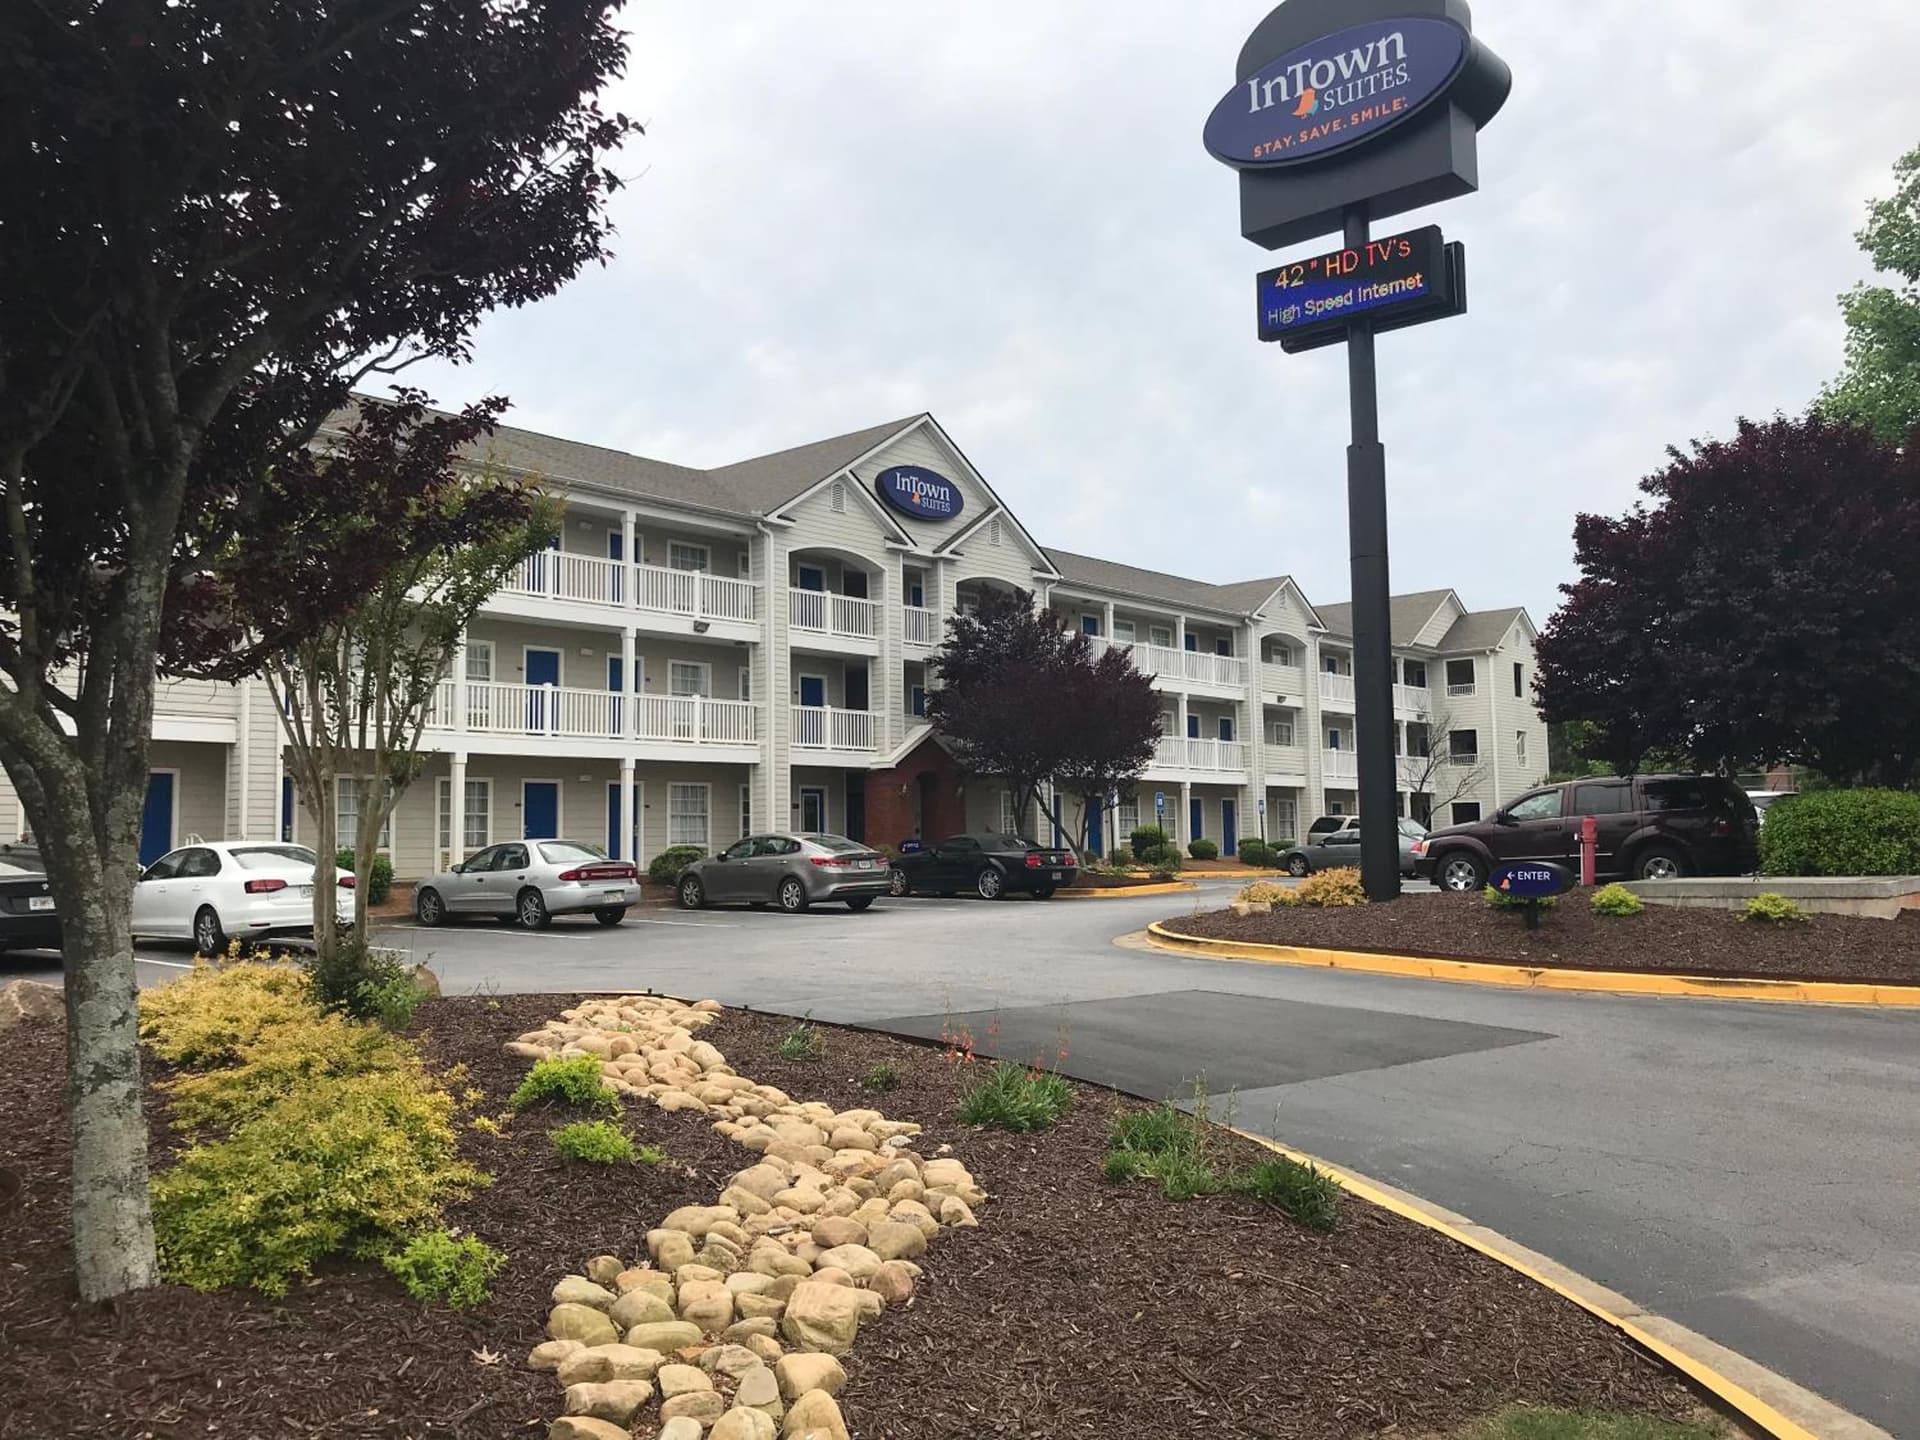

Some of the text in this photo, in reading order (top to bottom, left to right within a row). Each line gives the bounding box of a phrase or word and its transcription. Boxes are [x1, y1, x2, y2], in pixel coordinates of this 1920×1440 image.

[1248, 32, 1407, 114] InTown
[1253, 135, 1296, 158] STAY.
[1299, 119, 1347, 143] SAVE.
[1325, 249, 1360, 278] HD
[1367, 238, 1411, 267] TV's
[1267, 272, 1423, 325] High Speed Internet
[895, 472, 950, 501] InTown
[921, 497, 951, 512] SUITES
[1517, 871, 1551, 881] ENTER
